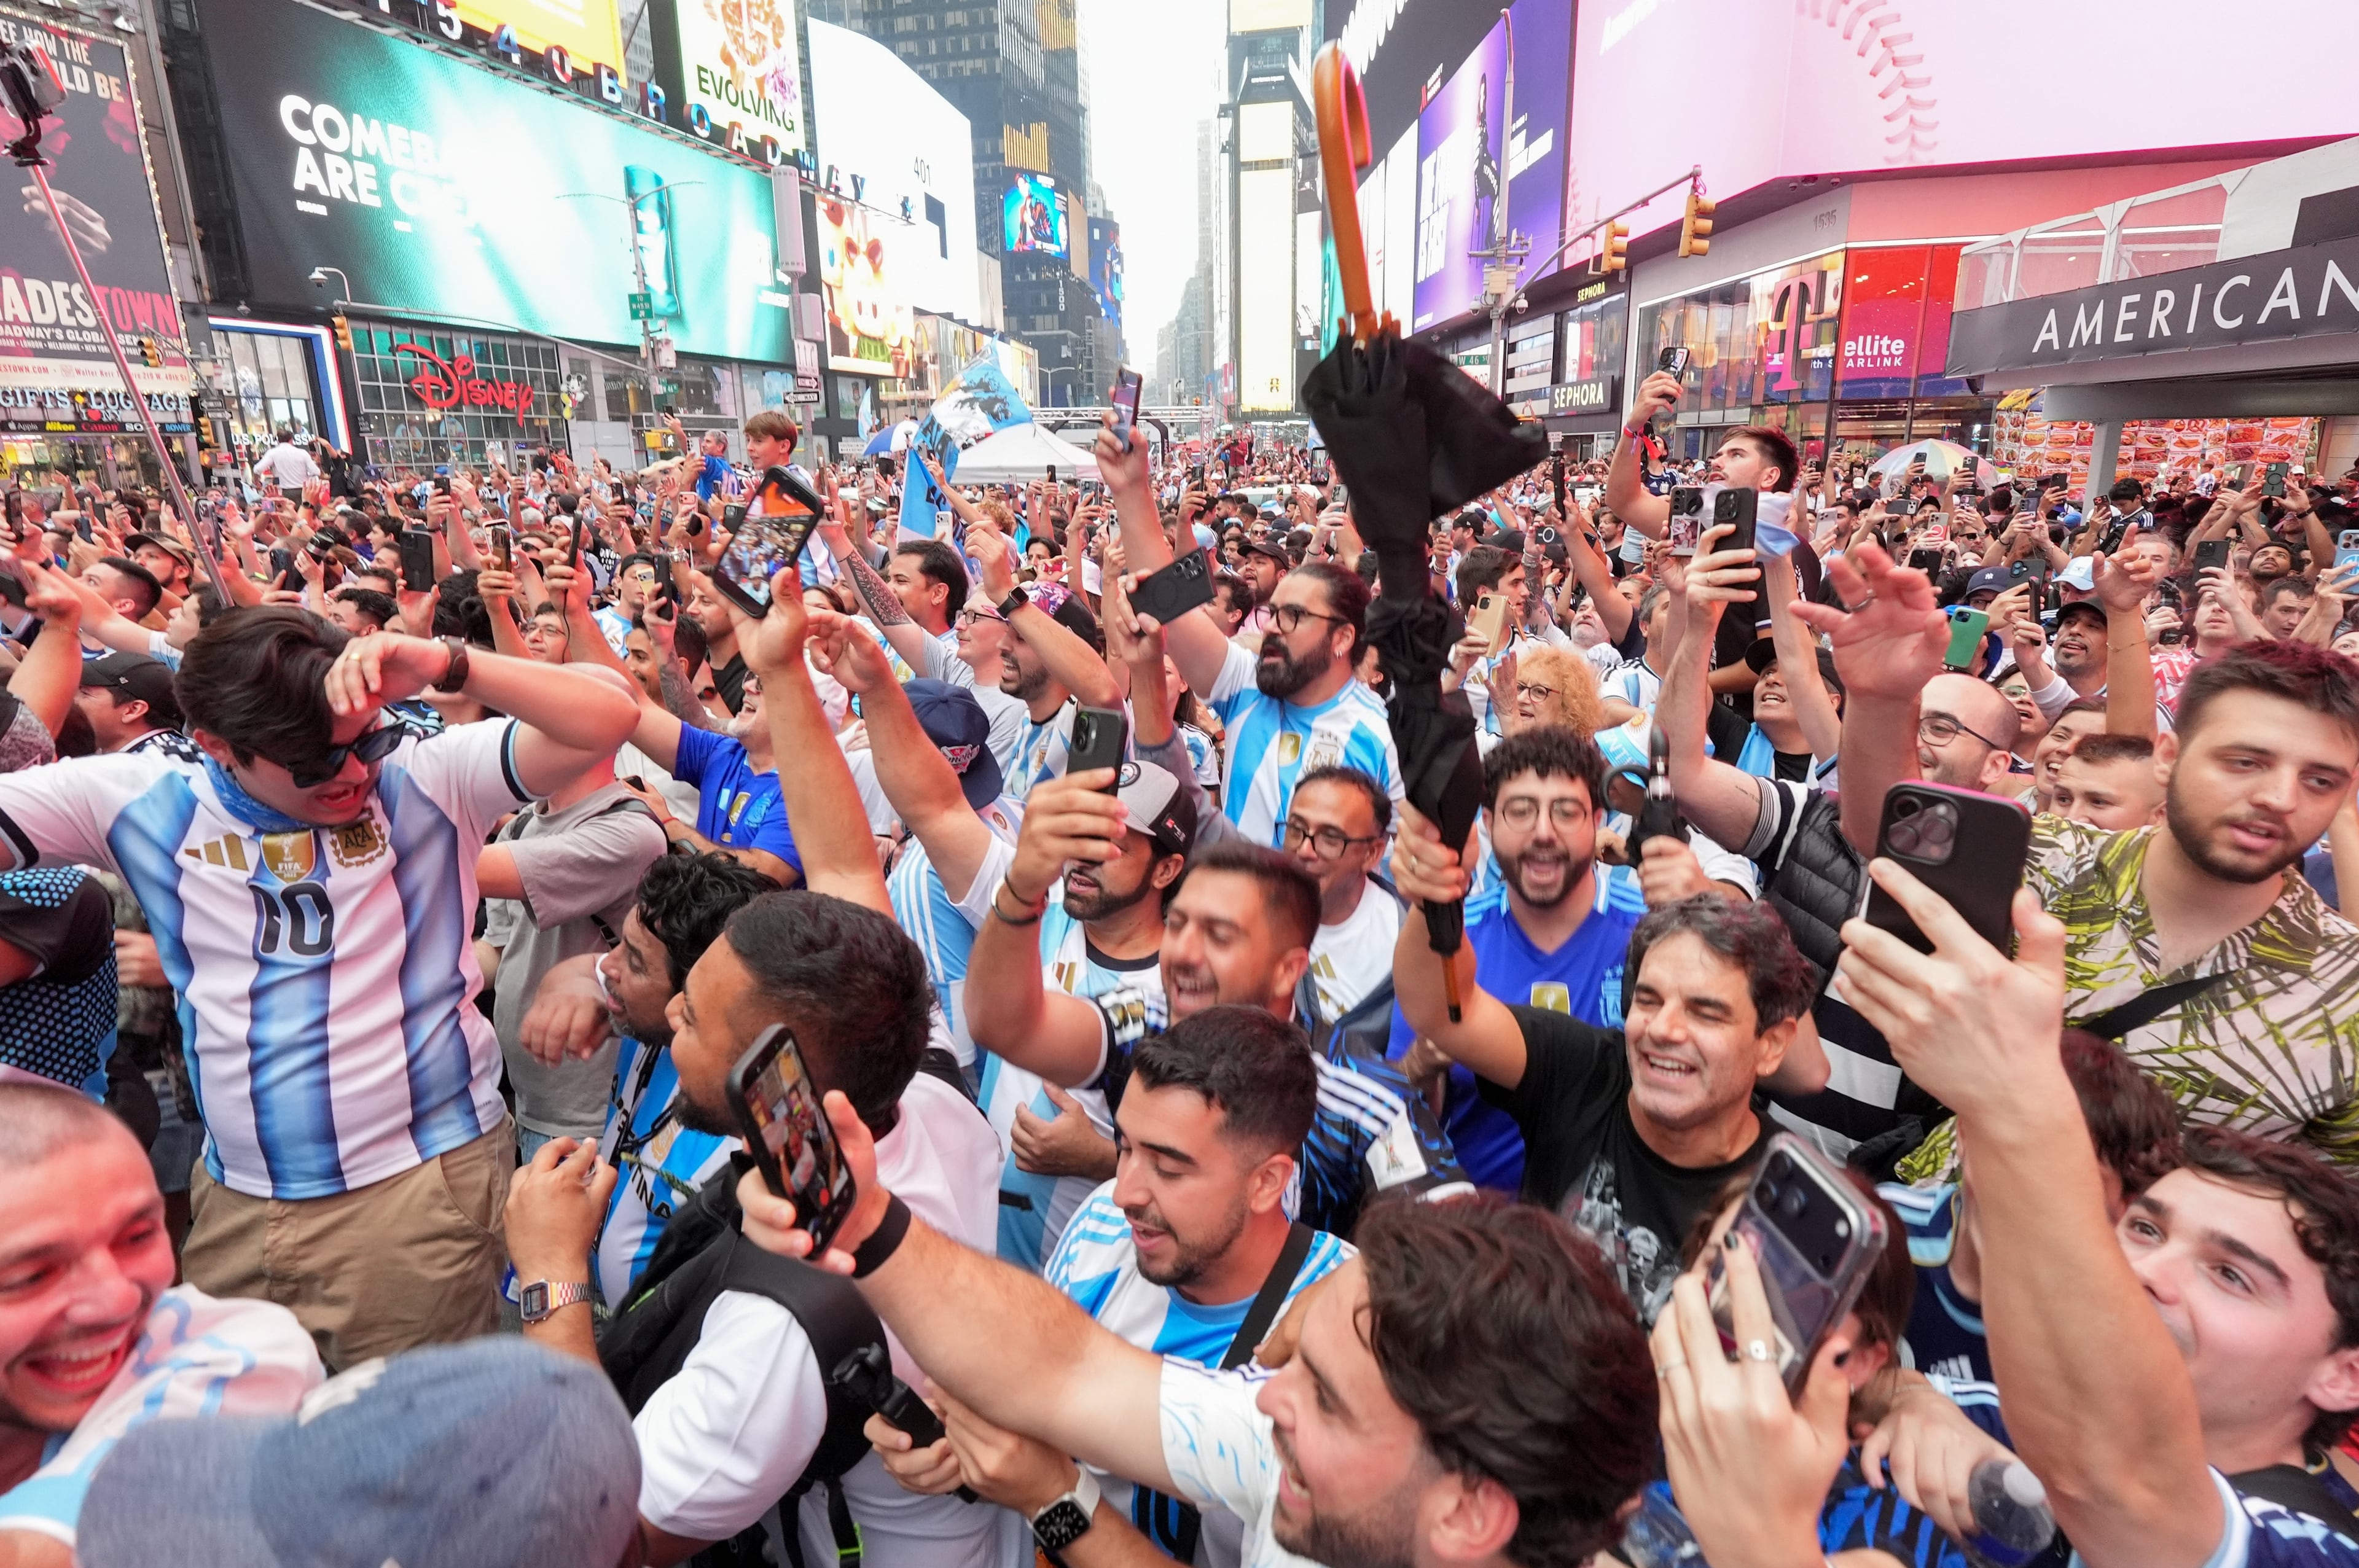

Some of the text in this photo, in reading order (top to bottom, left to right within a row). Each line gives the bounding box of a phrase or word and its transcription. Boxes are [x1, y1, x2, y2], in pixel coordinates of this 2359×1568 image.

[60, 36, 92, 66] THE
[93, 71, 124, 103] BE
[697, 64, 794, 133] EVOLVING
[294, 146, 381, 208] ARE
[1813, 209, 1837, 232] 1535
[1578, 281, 1605, 303] SEPHORA
[1844, 335, 1905, 356] ellite
[1458, 356, 1466, 365] W
[1469, 356, 1479, 365] 46
[1844, 357, 1903, 368] ARLINK
[0, 389, 190, 412] GIFTS LUGAGE
[1554, 382, 1603, 408] SEPHORA
[101, 409, 122, 422] NY
[17, 423, 38, 432] Apple
[45, 421, 76, 431] Nikon
[81, 422, 119, 432] Canon
[125, 423, 161, 432] SOY
[165, 423, 191, 432] BOWER
[231, 433, 253, 445] U.S.
[255, 434, 278, 445] POL
[277, 862, 301, 871] FIFA
[247, 878, 334, 958] 10
